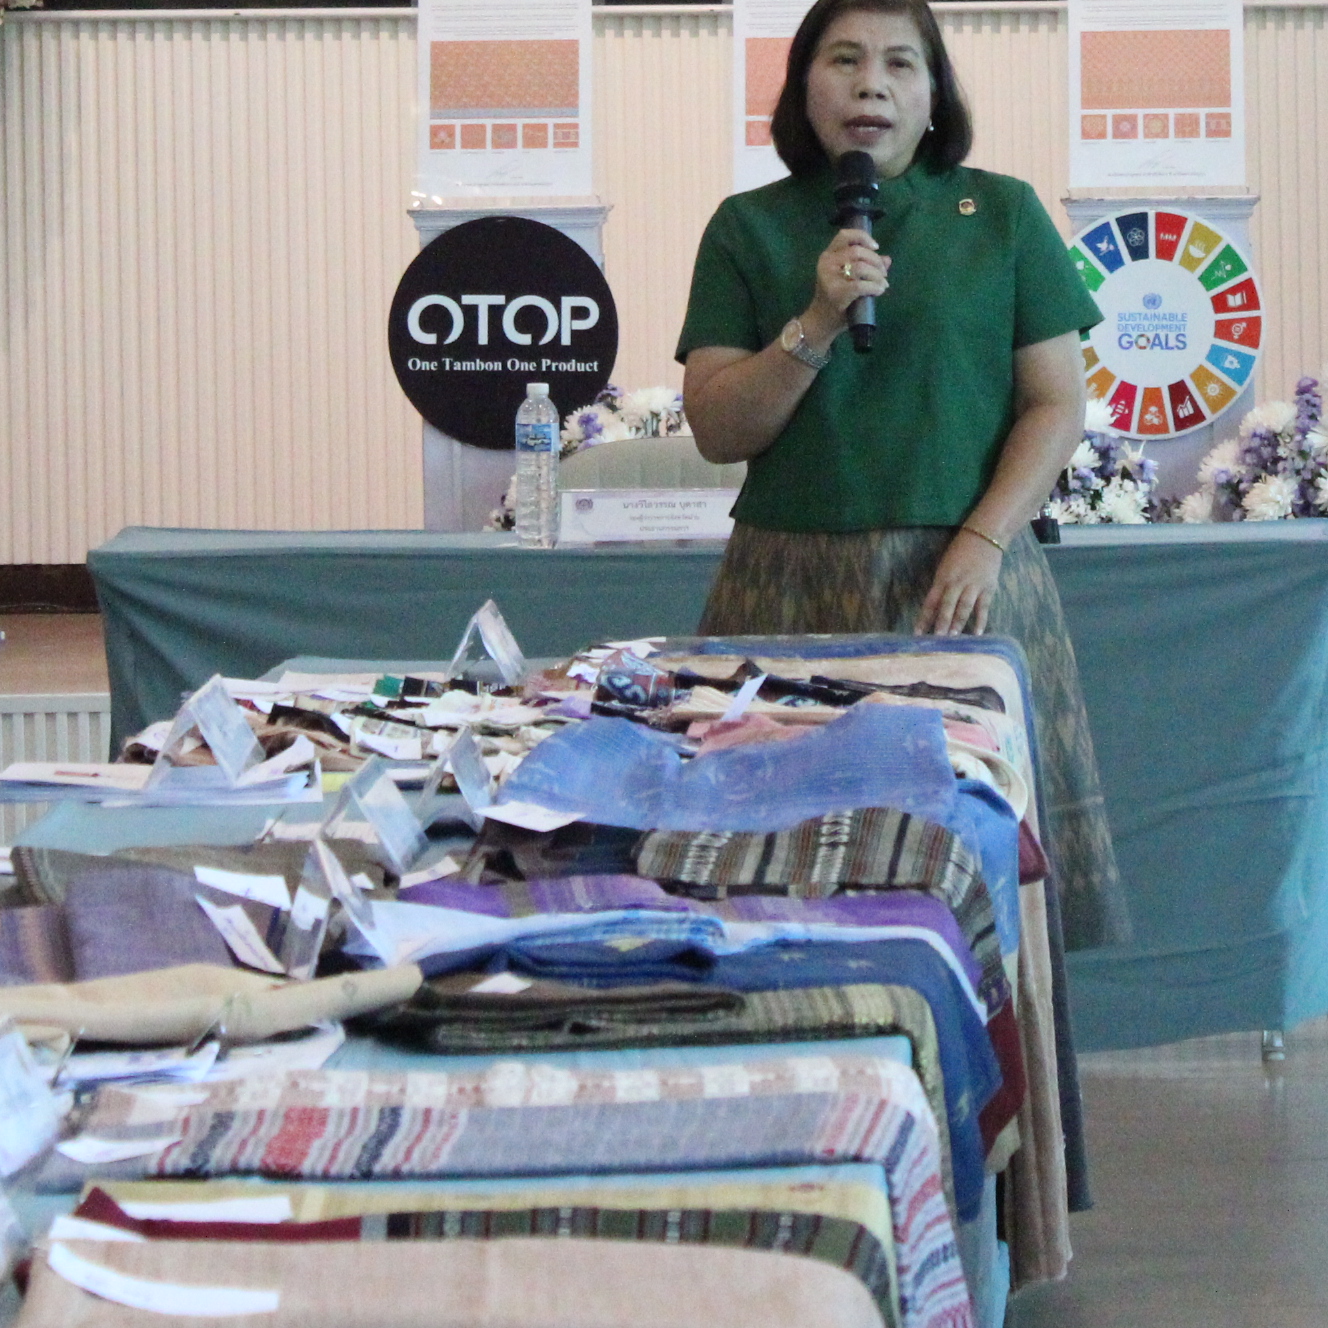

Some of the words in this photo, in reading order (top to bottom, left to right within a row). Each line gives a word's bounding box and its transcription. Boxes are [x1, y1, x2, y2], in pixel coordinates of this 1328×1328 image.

[407, 294, 600, 346] OTOP
[1117, 312, 1188, 322] SUSTAINABLE
[1117, 323, 1188, 332] DEVELOPMENT
[1118, 333, 1188, 350] GOALS
[407, 358, 438, 371] One
[442, 358, 503, 372] Tambon
[507, 358, 538, 372] One
[541, 358, 599, 372] Product
